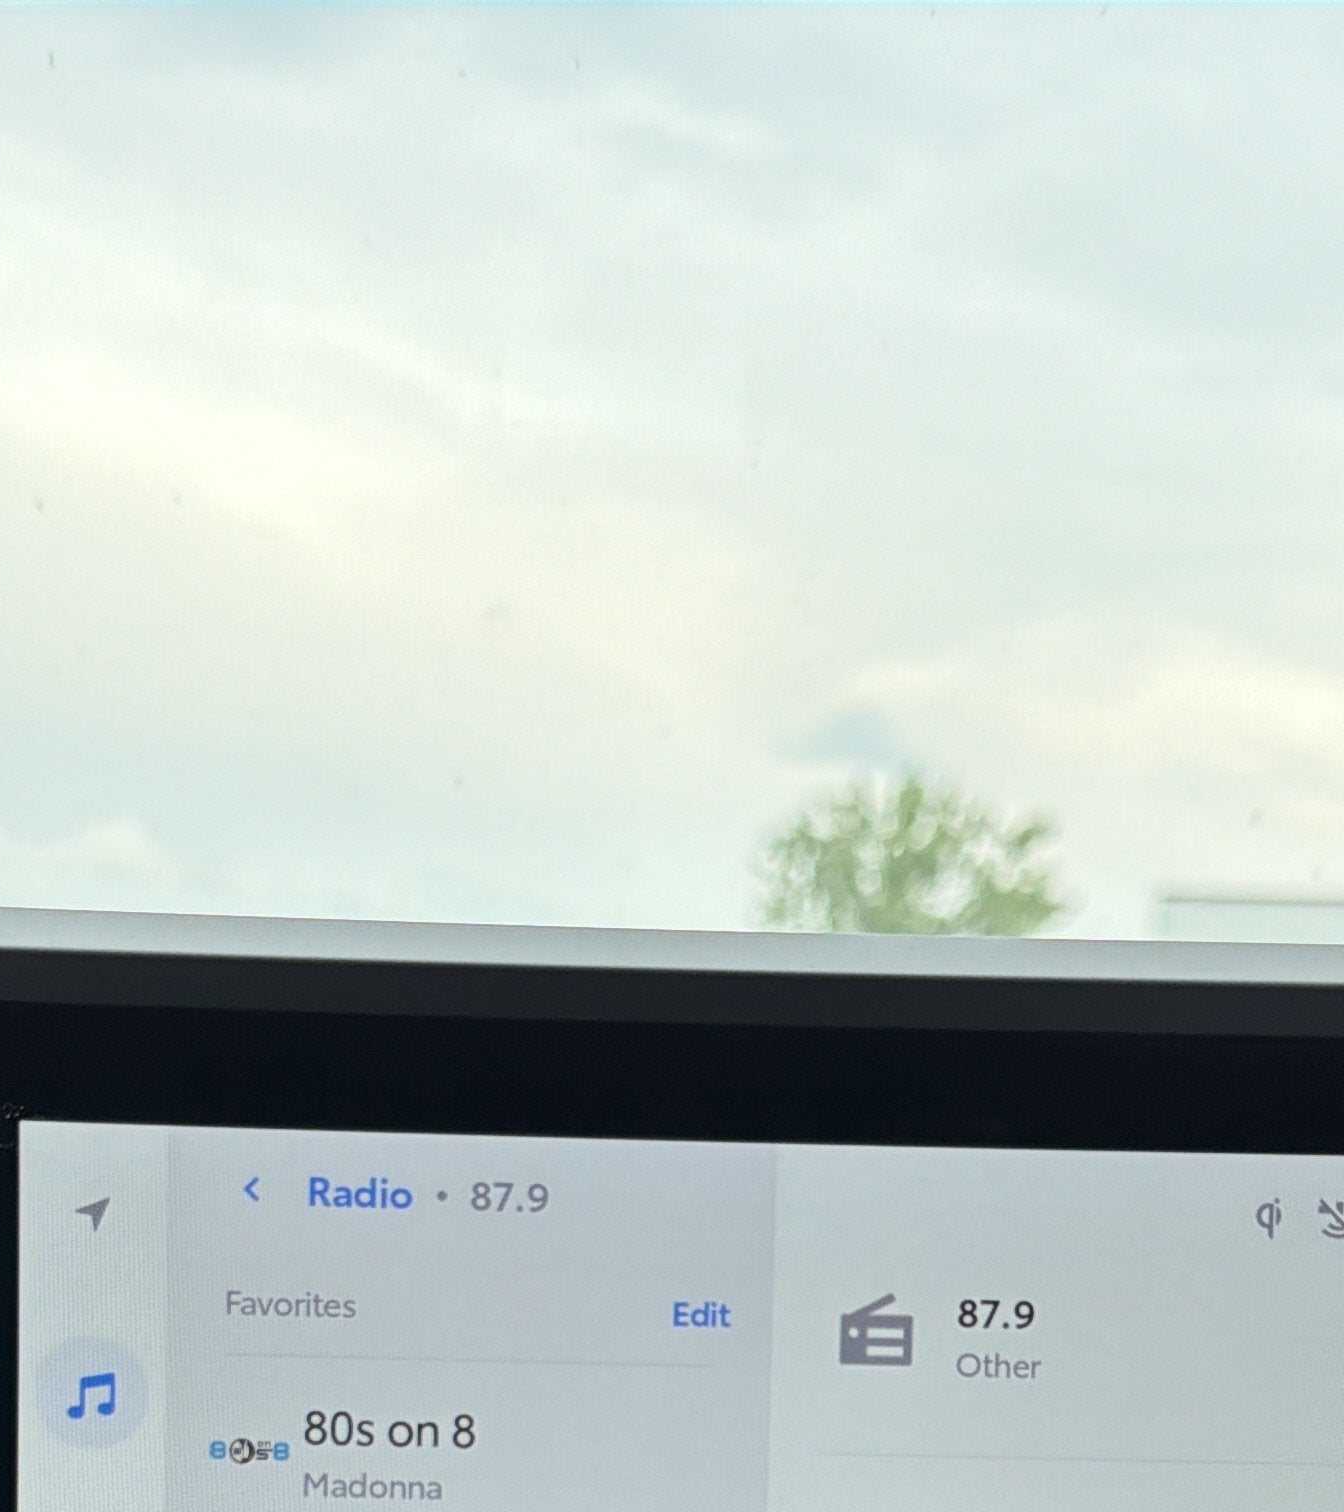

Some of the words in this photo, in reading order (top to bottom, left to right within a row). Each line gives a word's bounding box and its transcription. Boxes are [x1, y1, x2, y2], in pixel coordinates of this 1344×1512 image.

[308, 1176, 413, 1209] Radio
[471, 1182, 549, 1213] 87.9
[225, 1290, 356, 1319] Favorites
[673, 1301, 731, 1328] Edit
[957, 1298, 1035, 1331] 87.9
[955, 1351, 1042, 1381] Other
[304, 1411, 375, 1447] 80s
[388, 1420, 439, 1448] on
[452, 1414, 476, 1449] 8
[302, 1473, 443, 1500] Madonna
